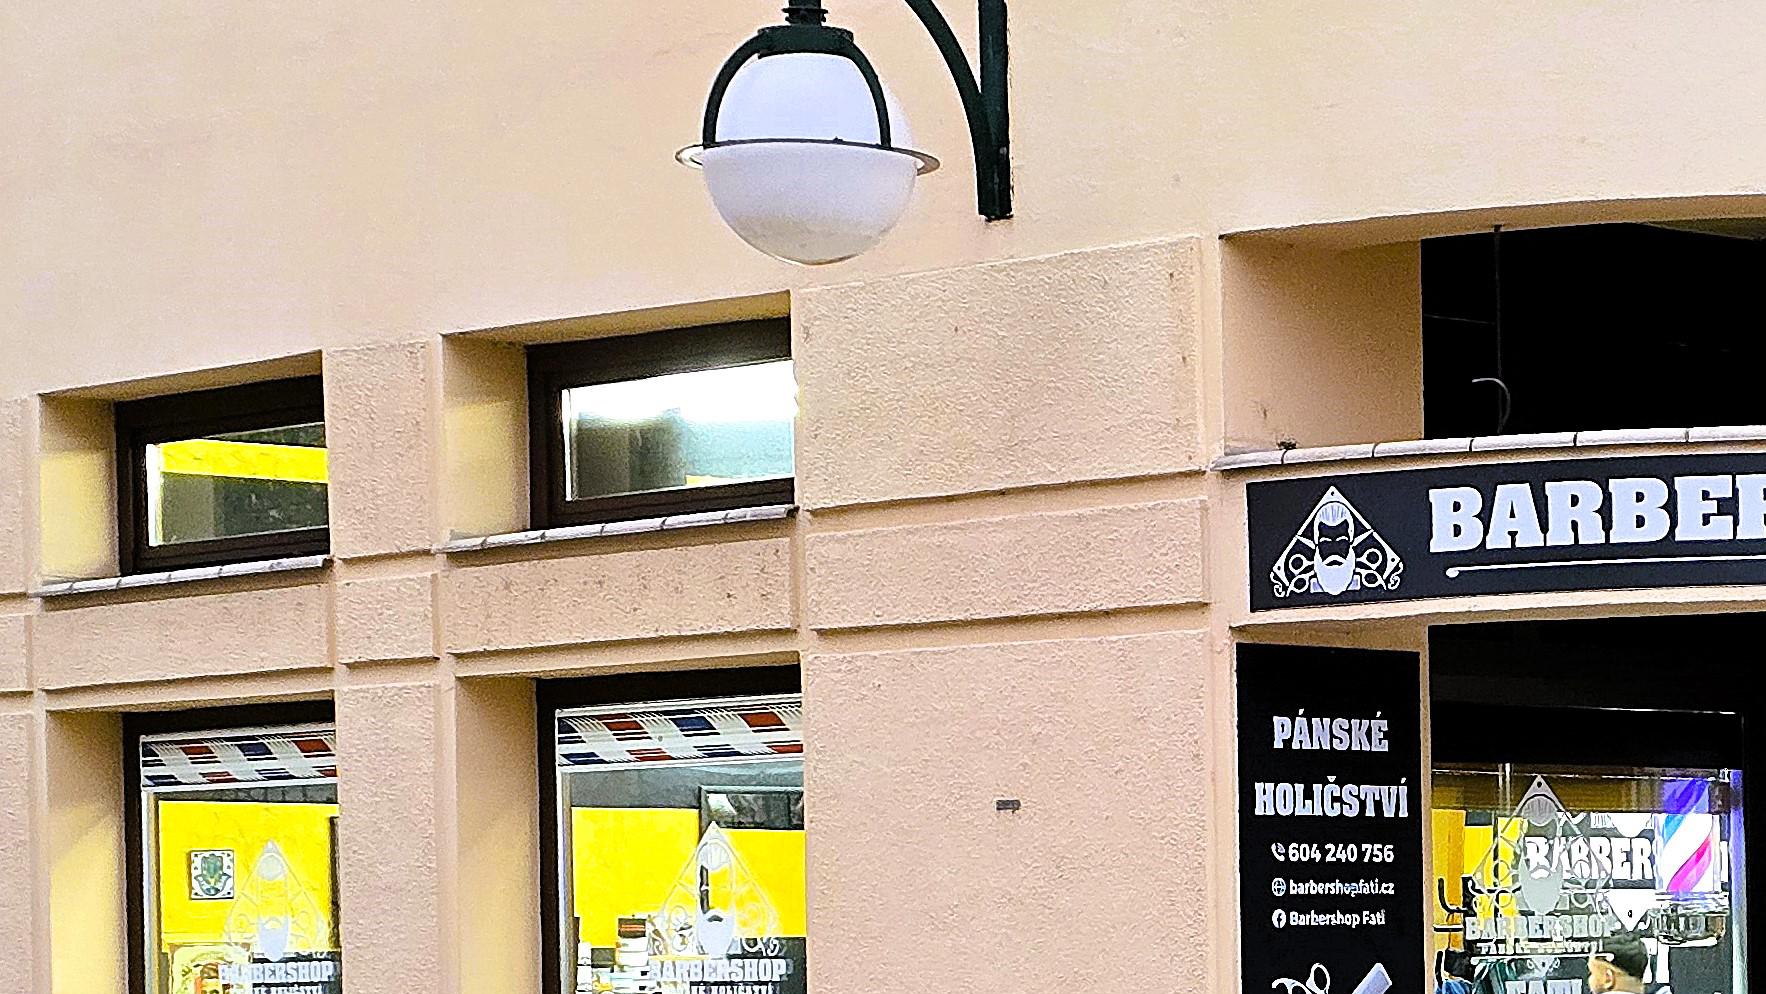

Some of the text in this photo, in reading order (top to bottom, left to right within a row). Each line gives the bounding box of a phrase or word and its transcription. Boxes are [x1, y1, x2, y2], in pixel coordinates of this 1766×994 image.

[1273, 708, 1389, 752] PÁNSKÉ
[1255, 775, 1409, 818] HOLIČSTVÍ
[1288, 842, 1395, 863] 604 240 756
[1289, 877, 1395, 897] barbershopfati.cz
[1289, 909, 1386, 929] Barbershop Fati
[650, 958, 786, 982] BARBERSHOP
